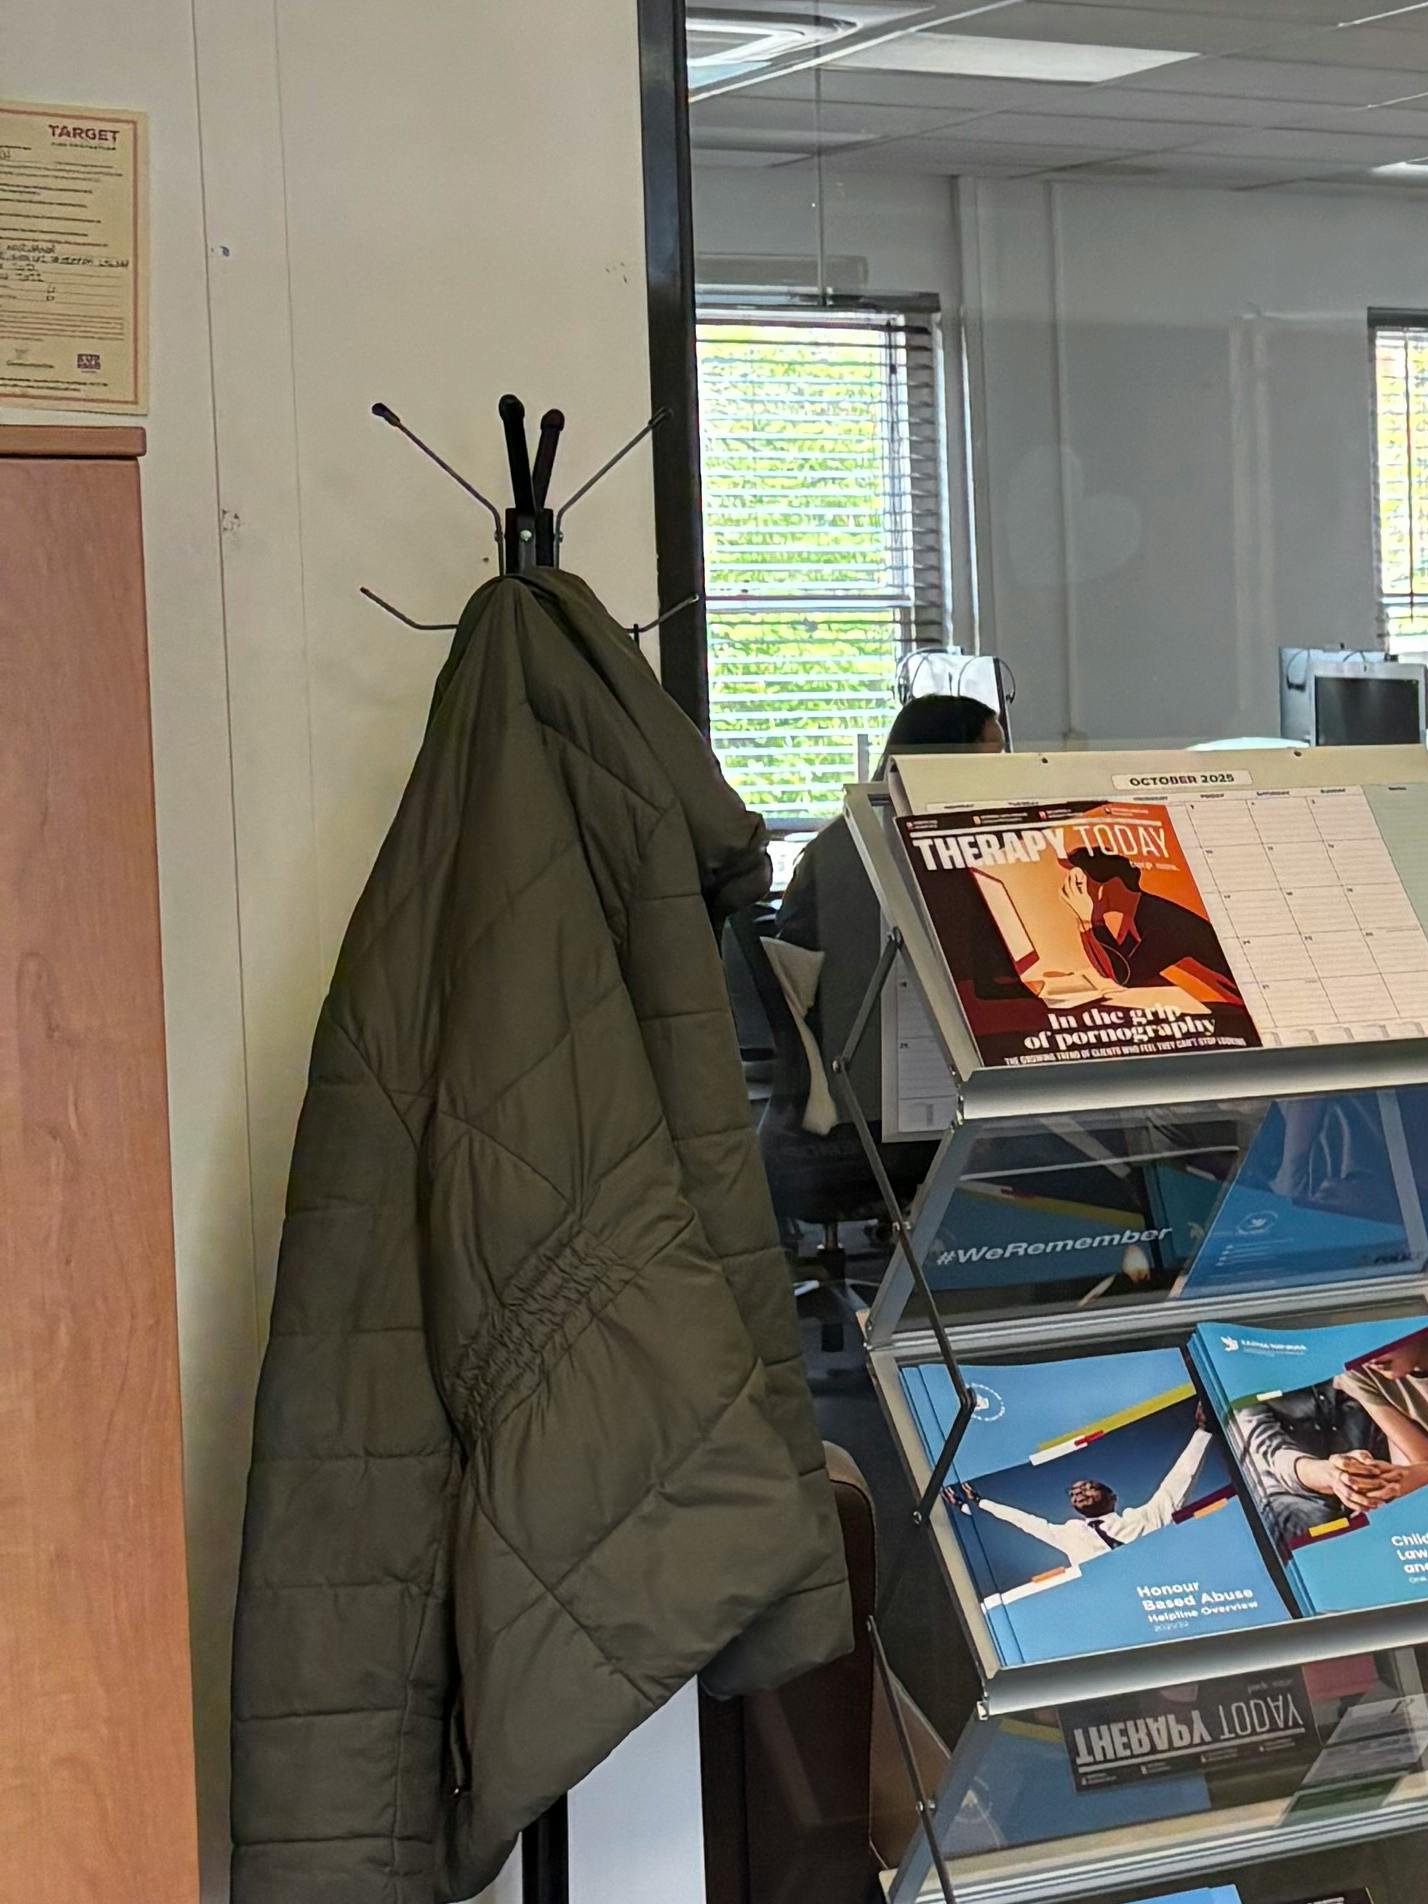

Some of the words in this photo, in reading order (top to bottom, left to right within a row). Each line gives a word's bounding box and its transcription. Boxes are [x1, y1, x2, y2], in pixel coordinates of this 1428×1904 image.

[48, 124, 120, 143] TARGET
[1129, 775, 1197, 787] OCTOBER
[1201, 773, 1235, 784] 2025
[912, 825, 1069, 872] THERAPY
[1073, 823, 1170, 859] TODAY
[1048, 1011, 1078, 1031] In
[1082, 1007, 1124, 1028] the
[1130, 1003, 1181, 1025] grip
[1024, 1030, 1052, 1051] of
[1055, 1015, 1216, 1050] pornography
[936, 1225, 1173, 1267] #WeRemember
[1396, 1548, 1428, 1561] Law
[1136, 1581, 1200, 1598] Honour
[1142, 1595, 1197, 1611] Based
[1201, 1588, 1254, 1604] Abuse
[1147, 1608, 1199, 1623] Helpline
[1201, 1601, 1258, 1615] Overview
